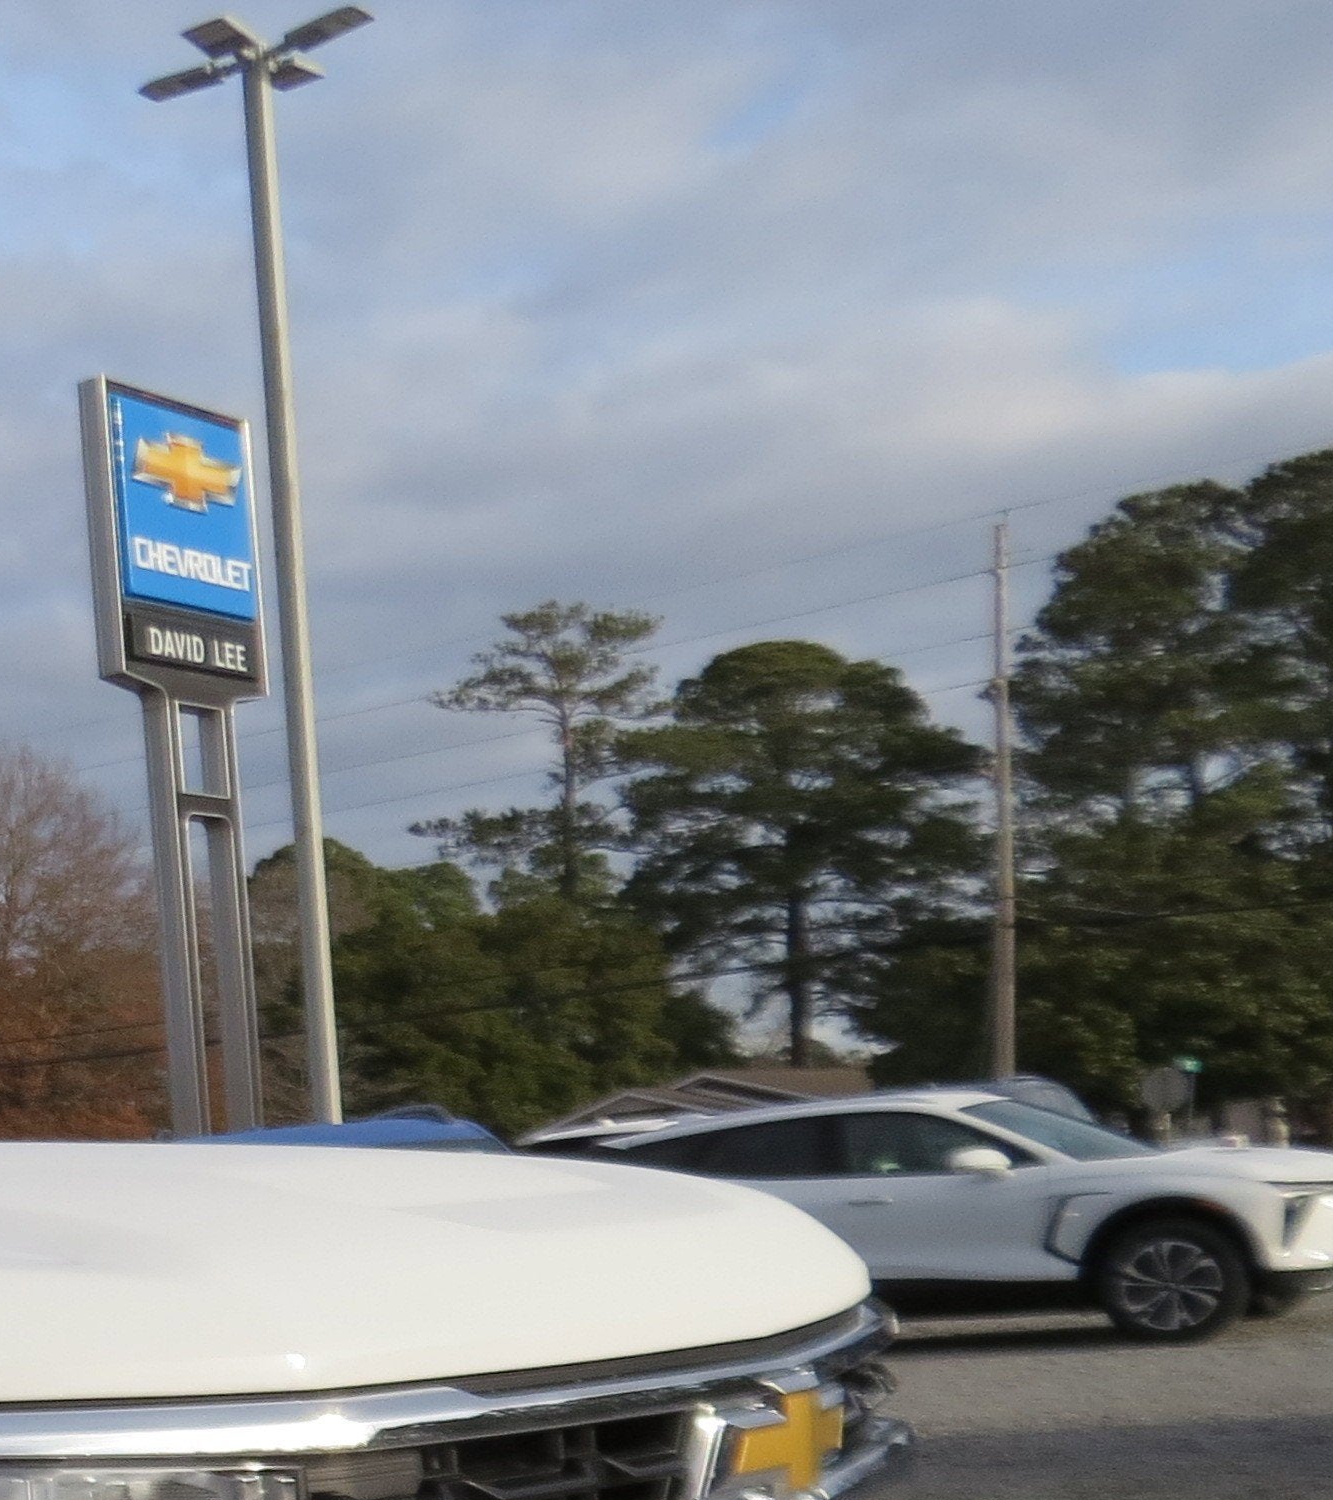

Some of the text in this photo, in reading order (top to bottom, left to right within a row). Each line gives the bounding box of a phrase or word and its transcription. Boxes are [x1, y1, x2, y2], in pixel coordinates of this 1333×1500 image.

[133, 536, 251, 592] CHEVROLET
[149, 626, 248, 673] DAVID LEE
